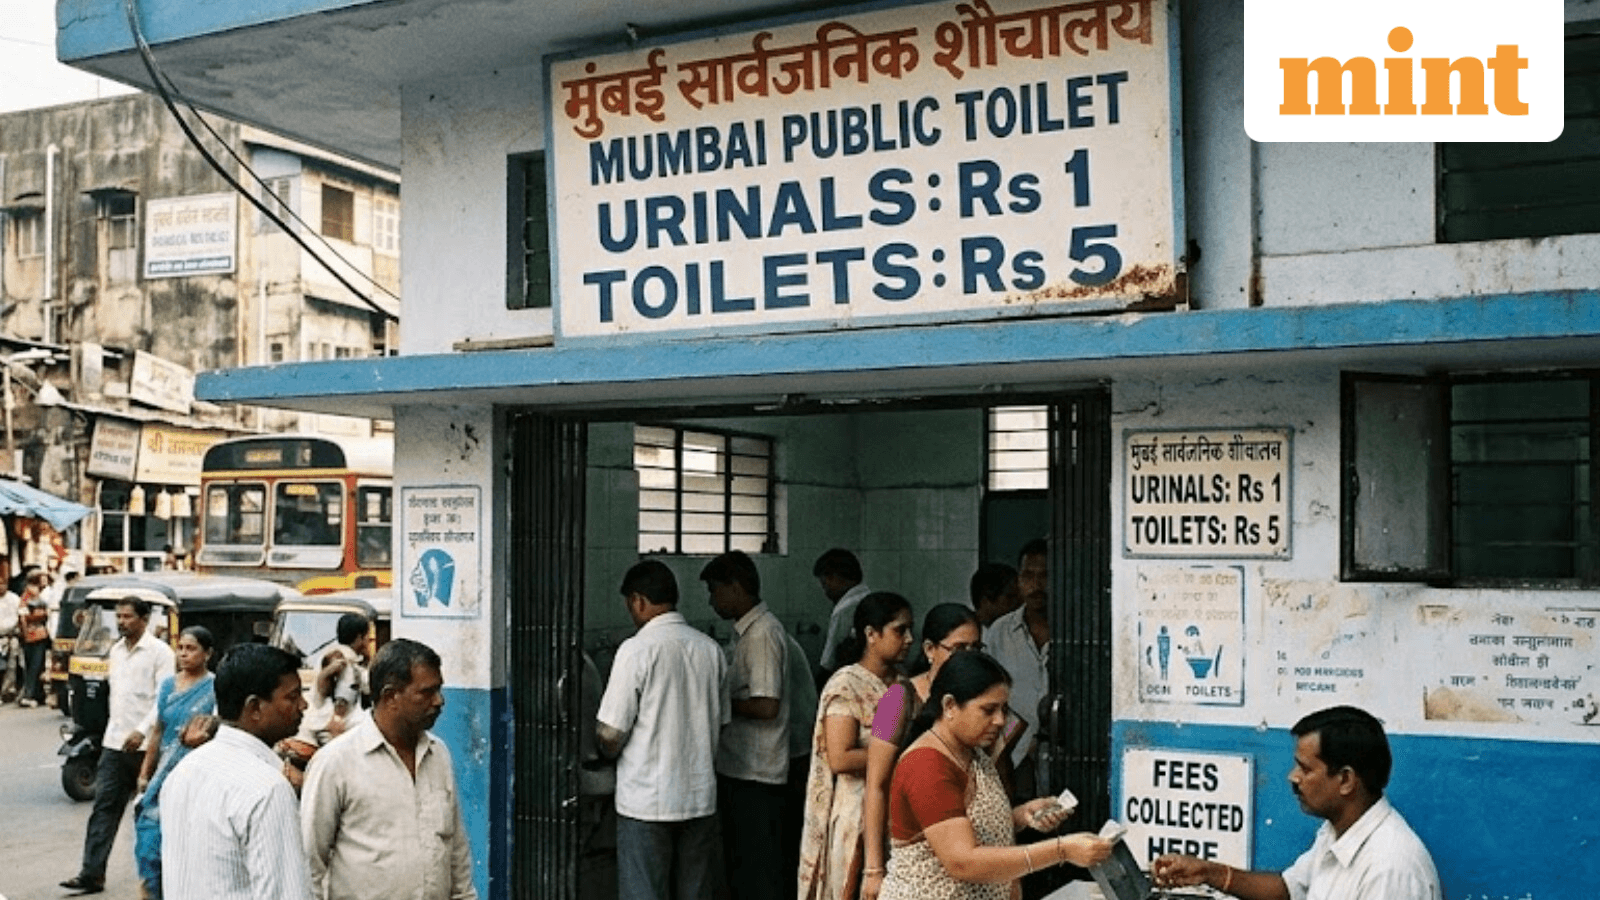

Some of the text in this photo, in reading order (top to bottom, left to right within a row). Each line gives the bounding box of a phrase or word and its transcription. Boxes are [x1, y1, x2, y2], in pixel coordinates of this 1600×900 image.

[561, 0, 1153, 139] मुंबई सार्वजनिक शौचालय
[589, 71, 1129, 186] MUMBAI PUBLIC TOILET
[958, 160, 1042, 219] Rs
[1064, 149, 1091, 207] 1
[961, 236, 1047, 295] Rs
[1067, 224, 1124, 287] 5
[1131, 472, 1281, 504] URINALS: Rs 1
[1131, 514, 1280, 545] TOILETS: Rs 5
[1153, 759, 1219, 792] FEES
[1126, 796, 1244, 833] COLLECTED
